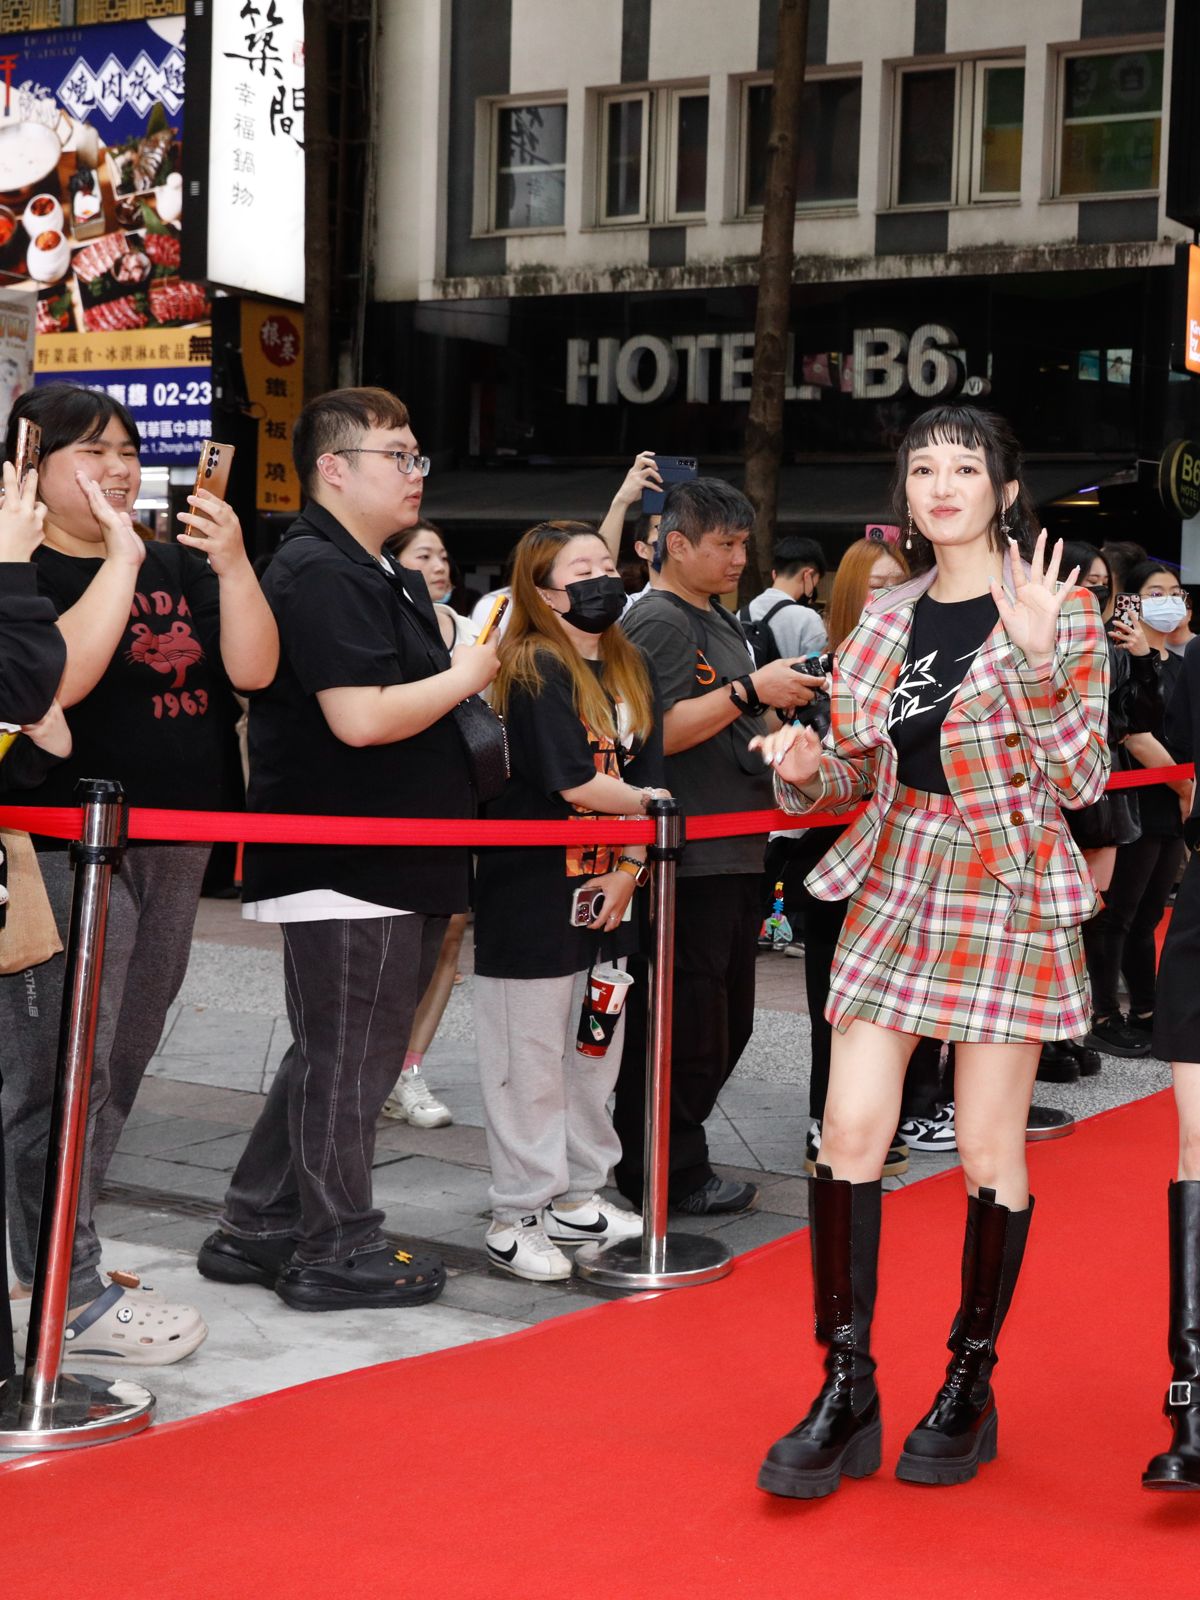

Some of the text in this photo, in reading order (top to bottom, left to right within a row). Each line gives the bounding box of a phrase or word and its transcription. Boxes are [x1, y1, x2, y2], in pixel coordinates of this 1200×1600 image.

[231, 83, 256, 207] 幸福鍋物
[153, 381, 212, 406] 02-23
[264, 377, 288, 483] 鐵板燒
[151, 689, 208, 719] 1963
